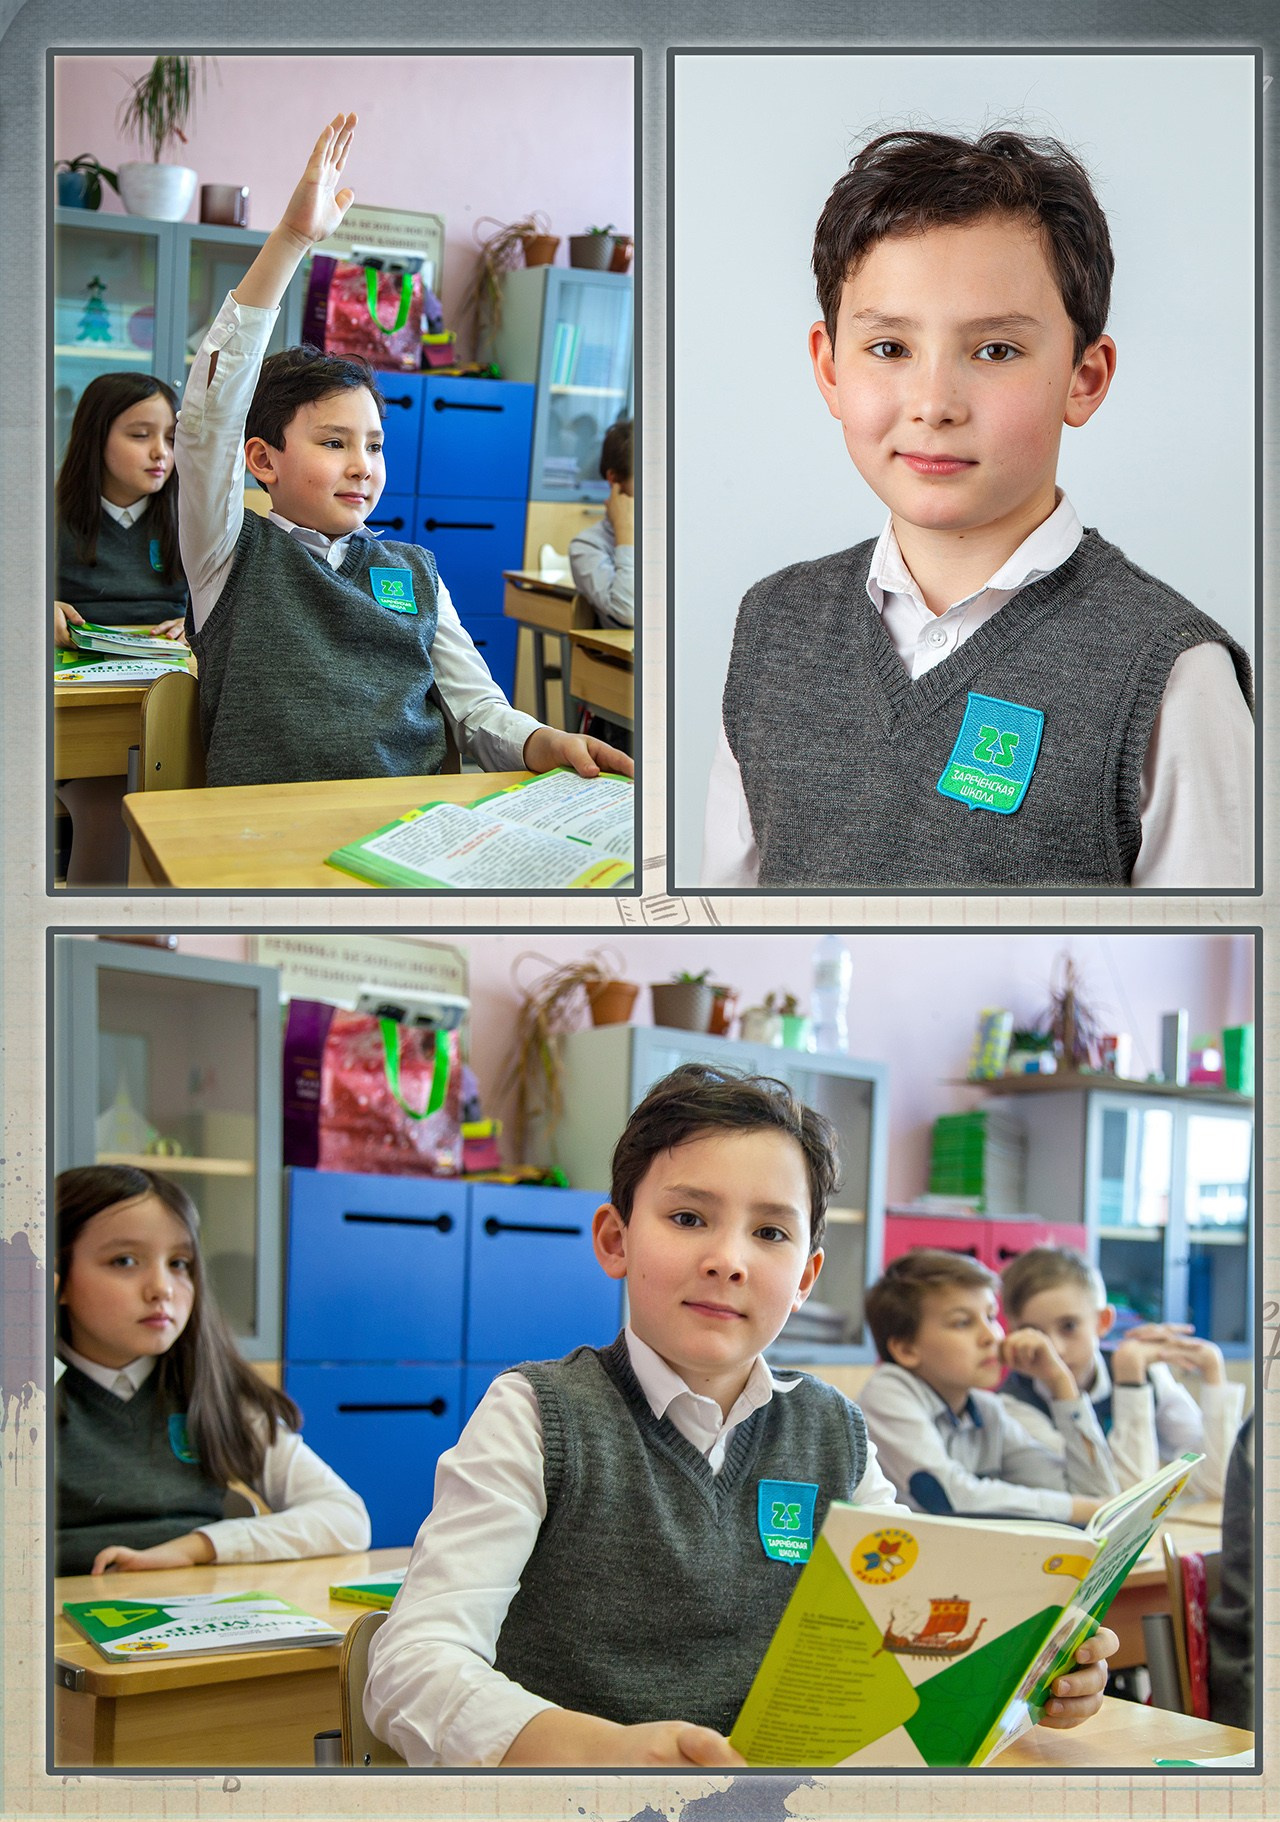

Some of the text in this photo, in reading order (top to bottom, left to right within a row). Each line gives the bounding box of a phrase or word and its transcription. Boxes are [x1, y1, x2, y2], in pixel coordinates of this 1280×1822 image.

[951, 770, 1015, 797] ЗАРЕЧЕНСКАЯ
[960, 785, 995, 805] ШКОЛА
[84, 1608, 158, 1628] 4
